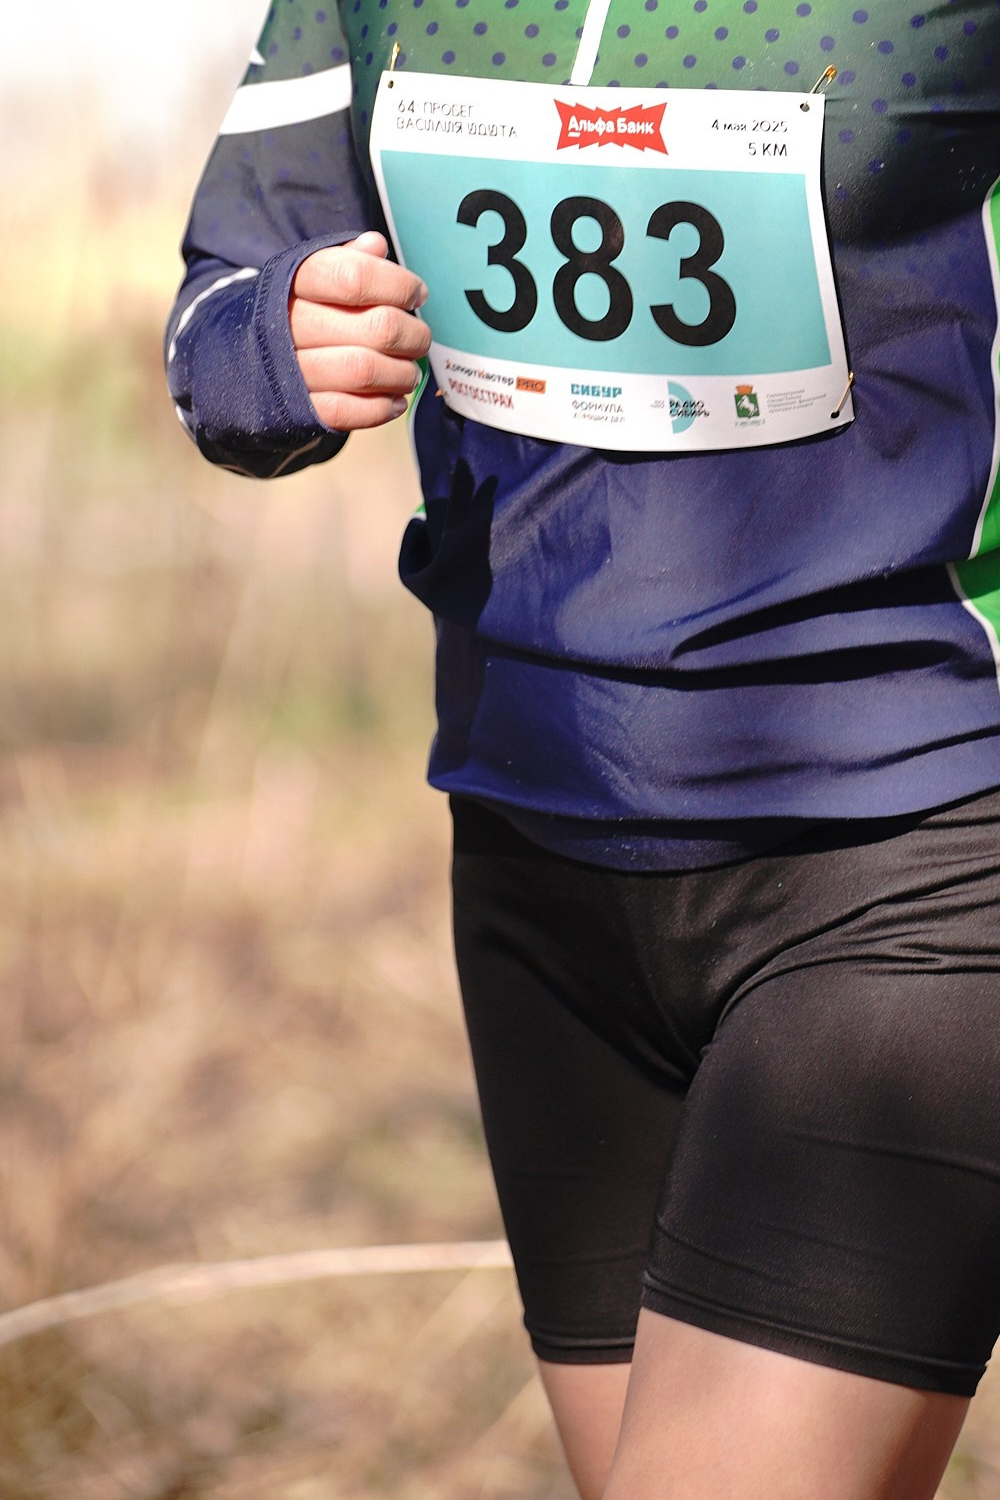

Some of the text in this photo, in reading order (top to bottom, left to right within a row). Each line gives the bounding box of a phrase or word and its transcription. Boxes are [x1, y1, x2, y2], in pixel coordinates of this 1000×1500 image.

[397, 99, 475, 118] 64 ПРОБЕГ
[396, 116, 463, 135] ВАСИЛИЯ
[567, 114, 655, 137] Альфа Банк
[711, 118, 788, 133] 4 мая 2025
[748, 142, 757, 156] 5
[456, 188, 737, 347] 383
[517, 379, 545, 393] PRO
[571, 383, 623, 398] СИБУР
[572, 399, 624, 413] ФОРМУЛА
[669, 399, 705, 409] РАДИО
[669, 408, 710, 418] СИБИРЬ
